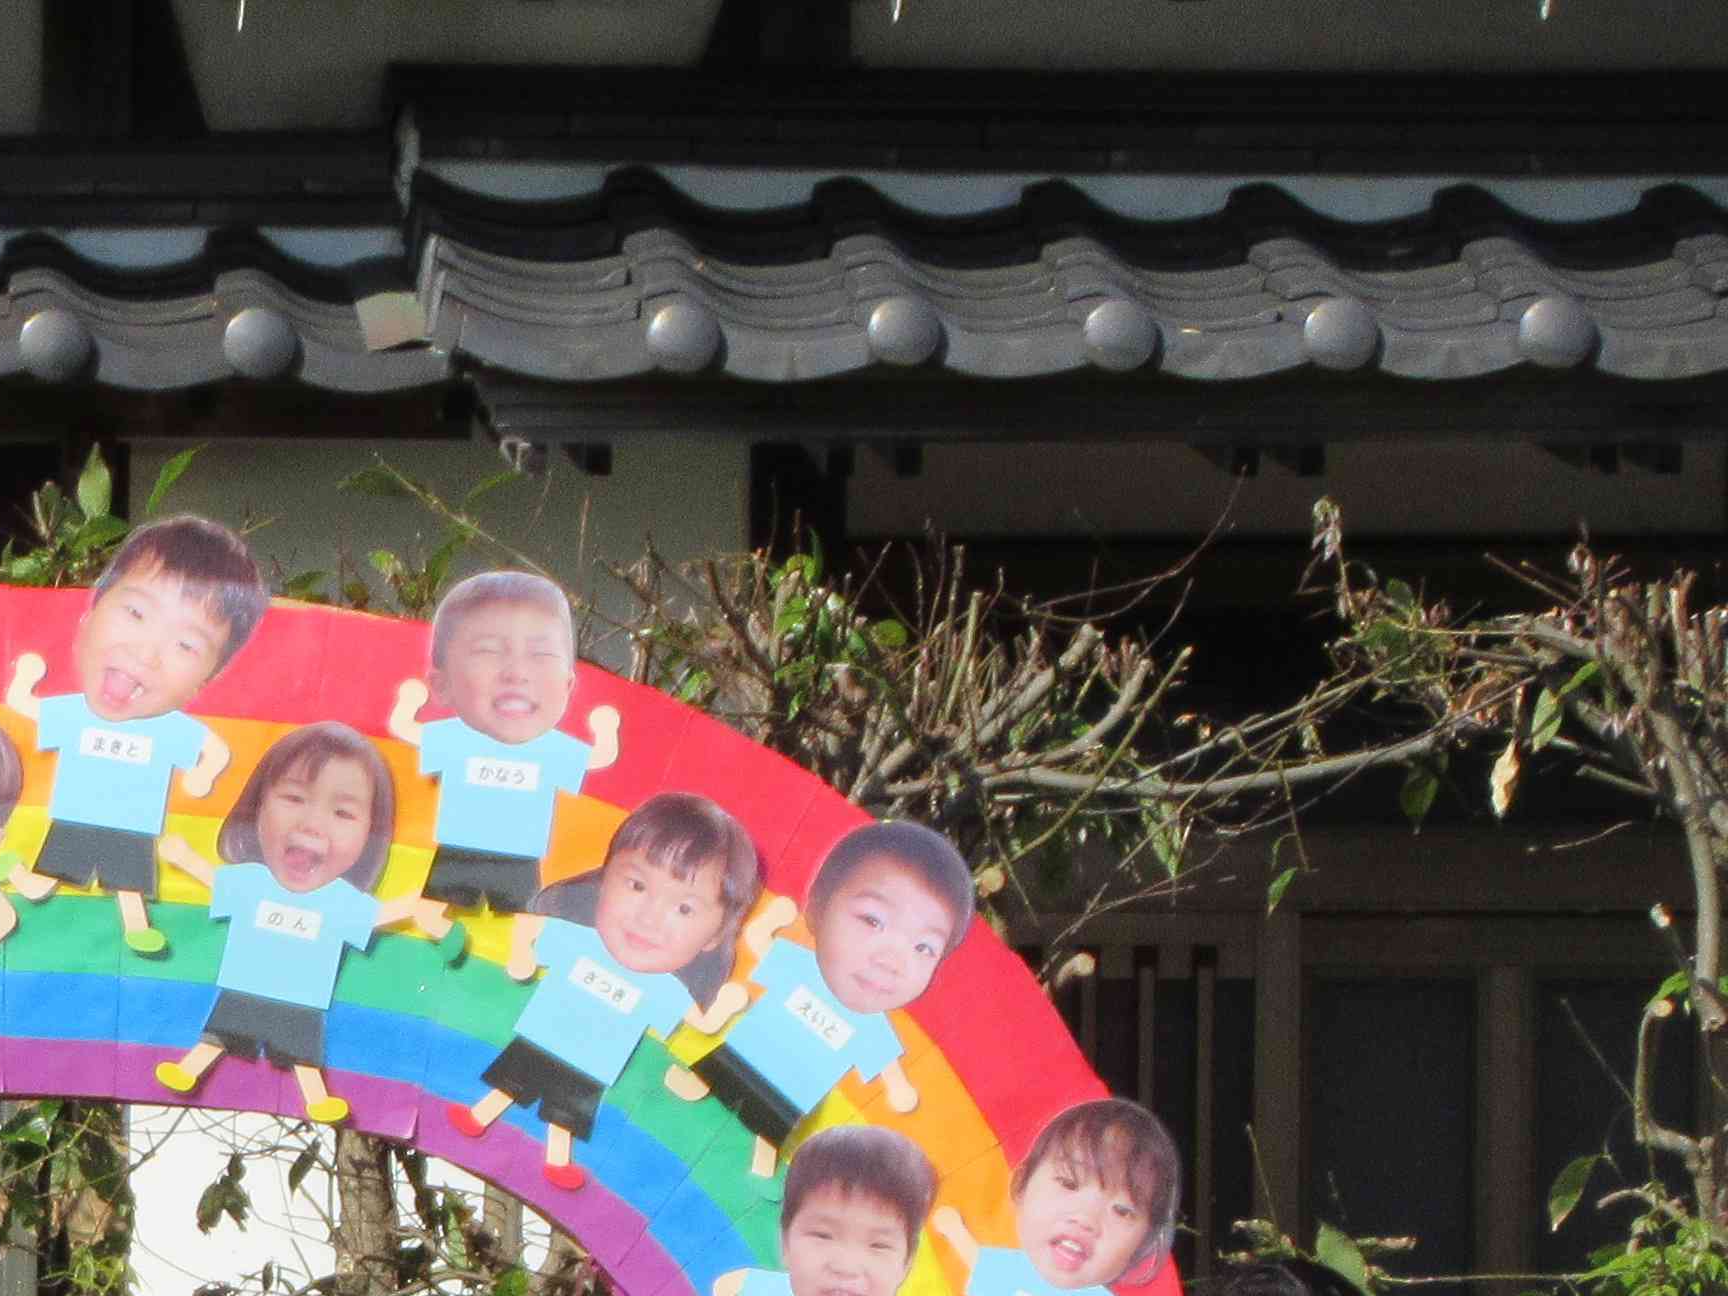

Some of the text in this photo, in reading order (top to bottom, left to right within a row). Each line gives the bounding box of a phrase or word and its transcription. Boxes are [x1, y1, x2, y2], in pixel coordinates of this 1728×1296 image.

[91, 735, 141, 758] まきと
[478, 764, 527, 785] かなう
[267, 909, 308, 933] のん
